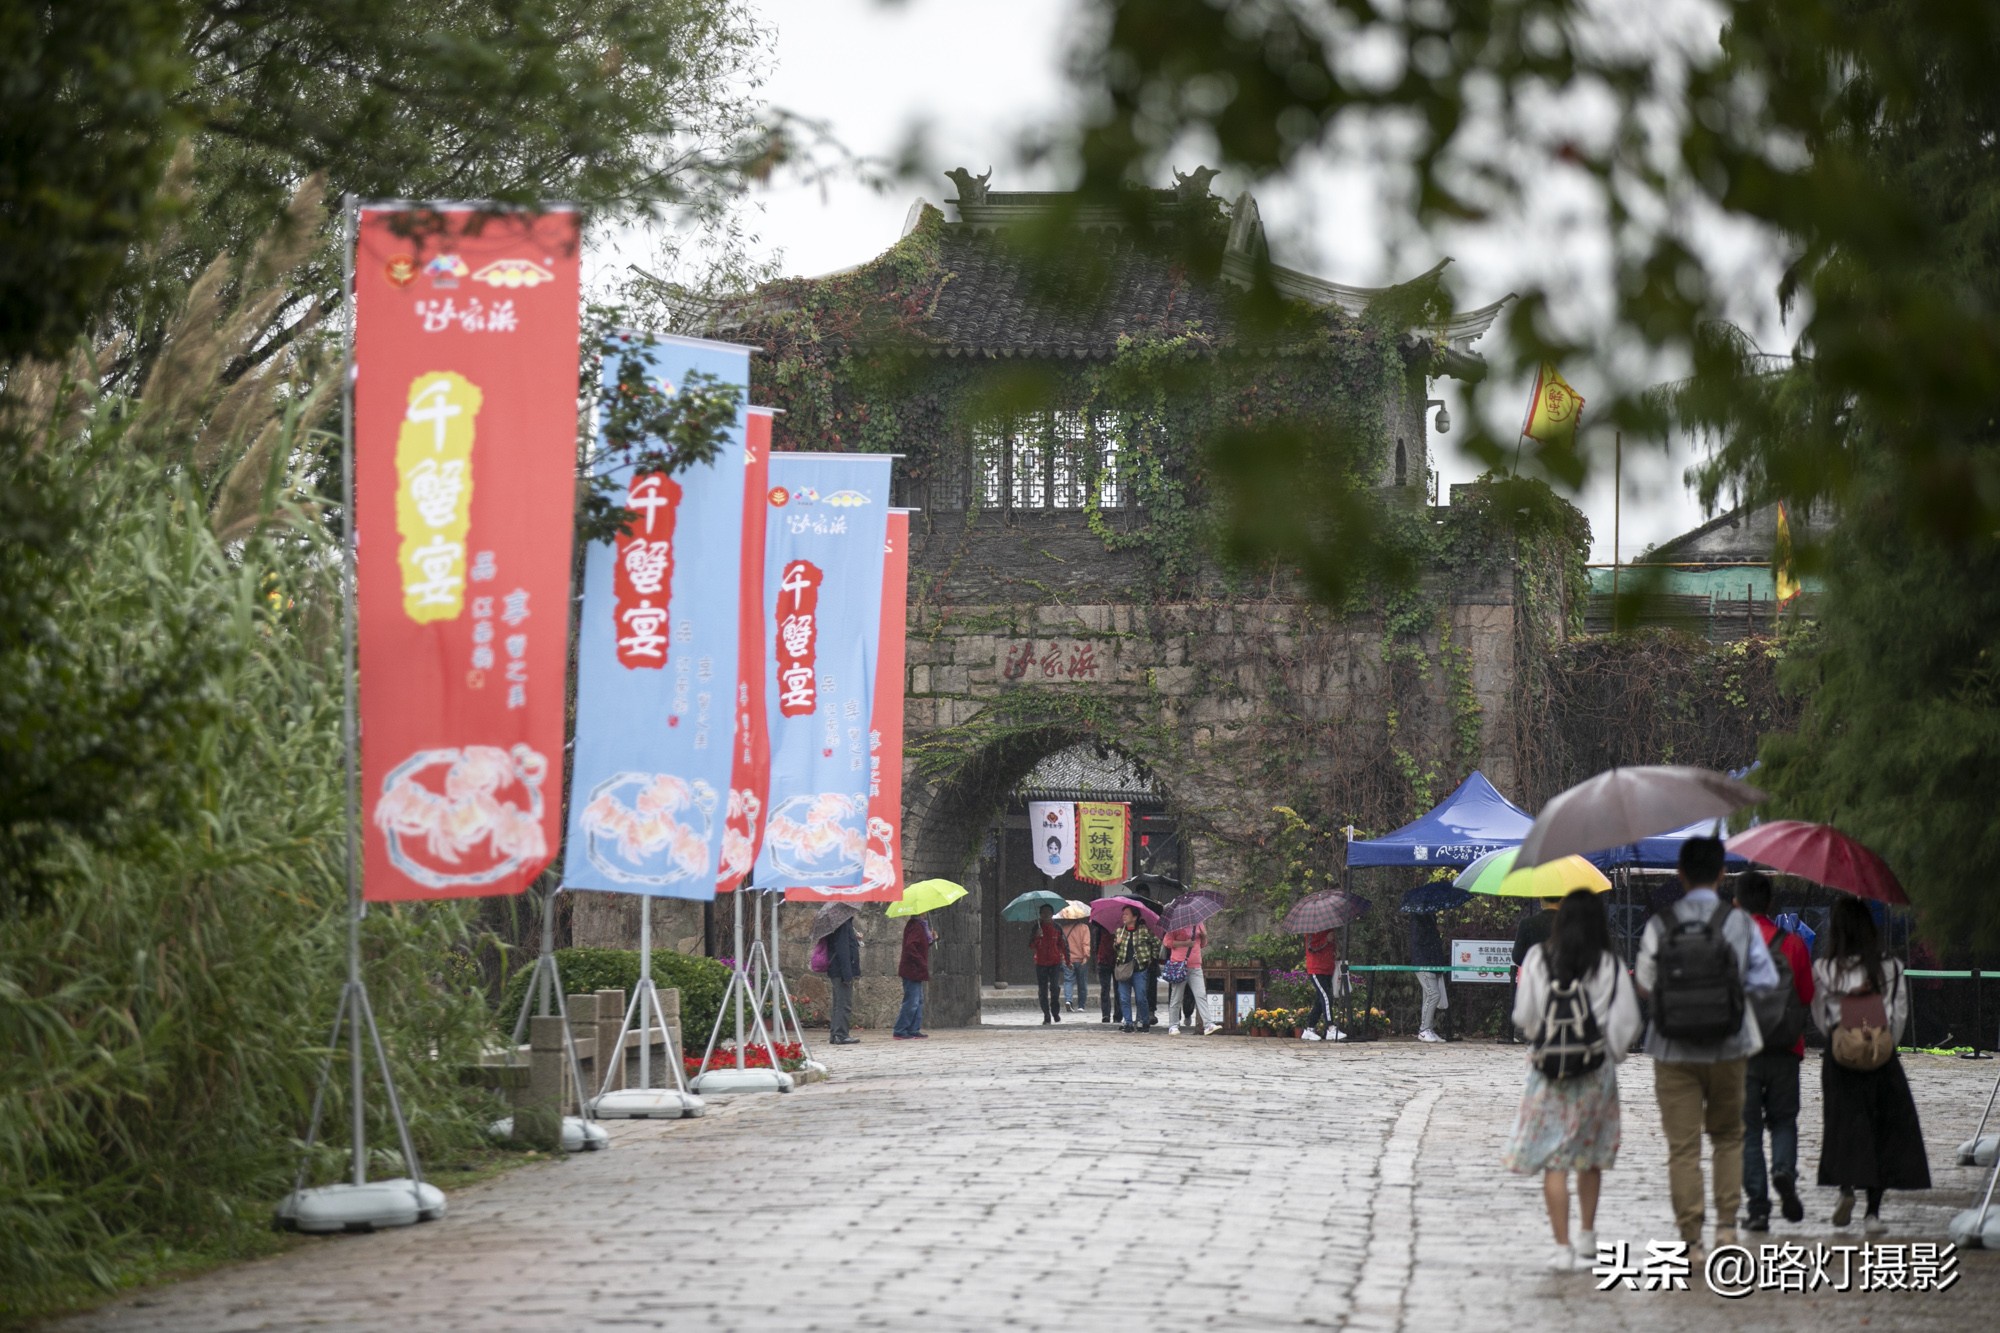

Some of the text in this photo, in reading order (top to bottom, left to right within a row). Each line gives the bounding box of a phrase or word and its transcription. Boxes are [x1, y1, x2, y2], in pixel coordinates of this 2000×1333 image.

[406, 379, 465, 607] 千蟹宴
[618, 476, 670, 658] 千蟹宴
[780, 563, 814, 708] 千蟹宴
[1003, 641, 1100, 680] 沙家浜
